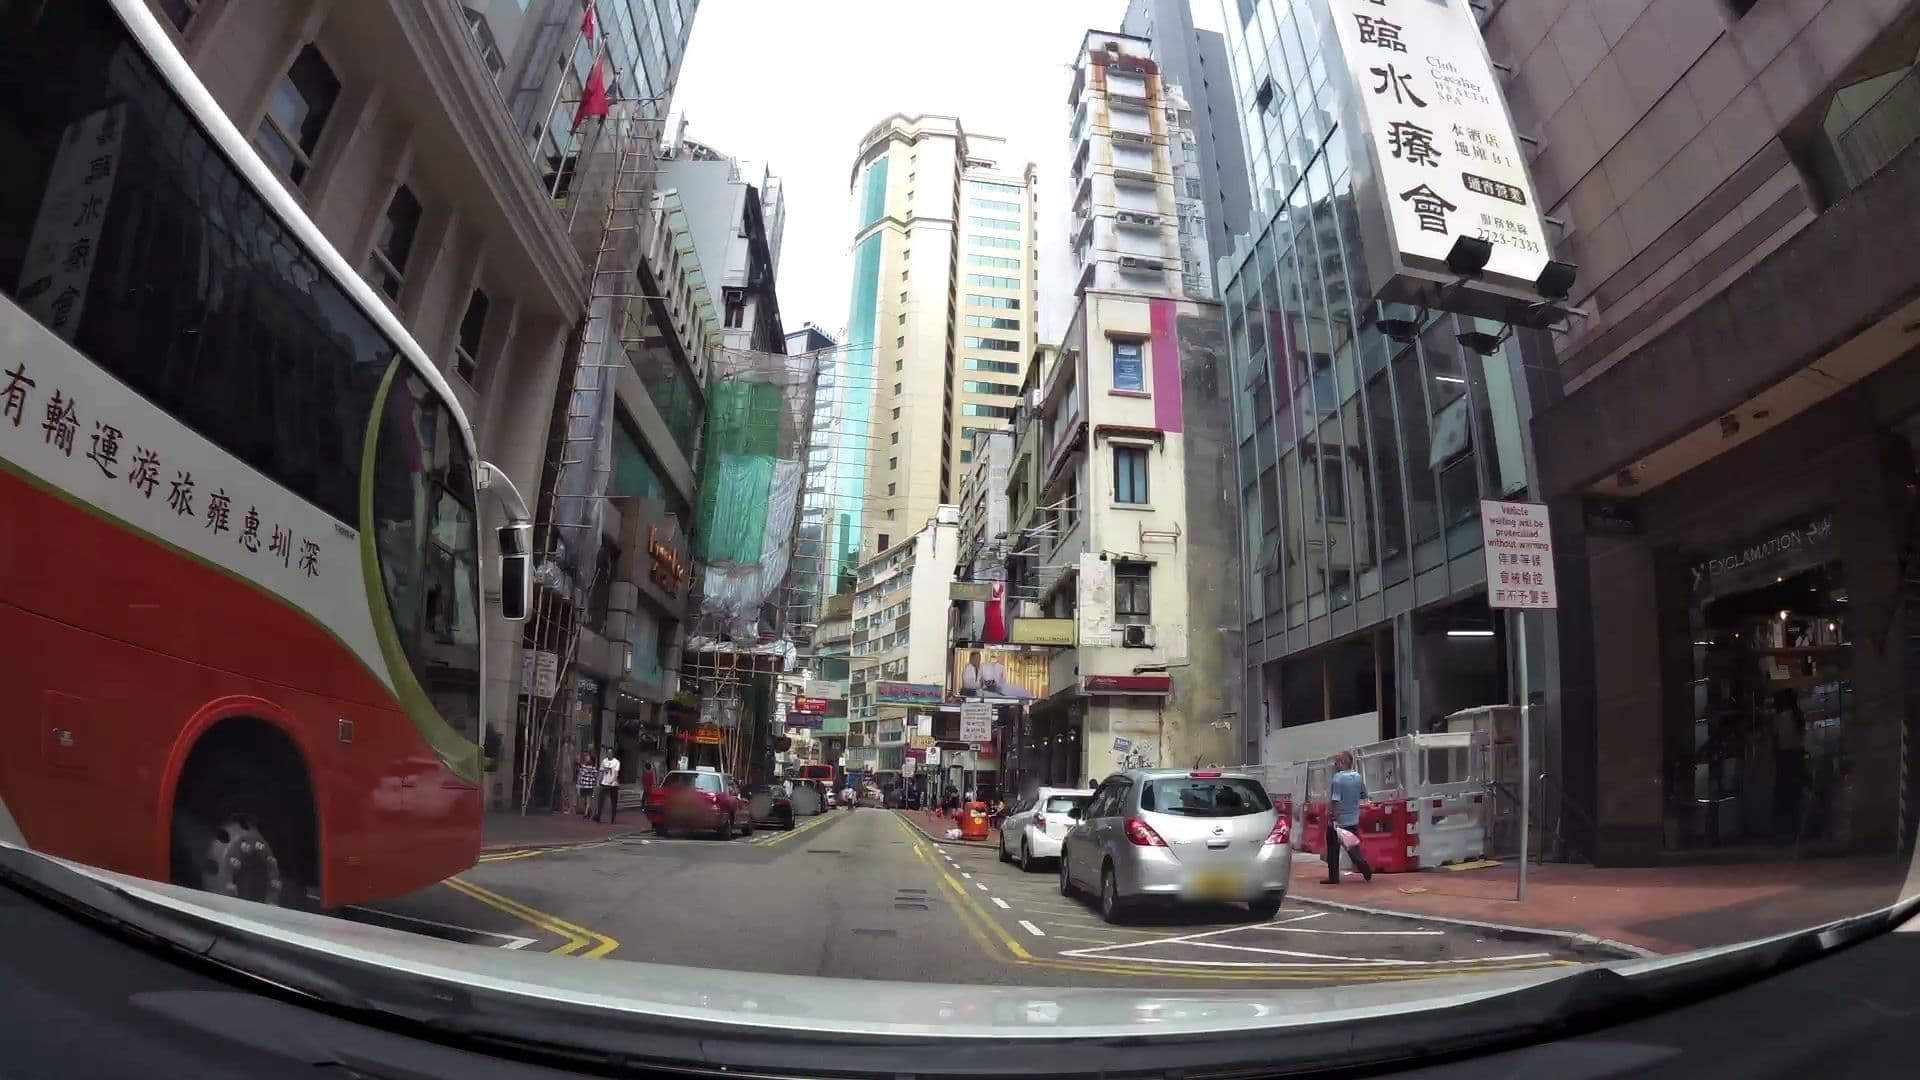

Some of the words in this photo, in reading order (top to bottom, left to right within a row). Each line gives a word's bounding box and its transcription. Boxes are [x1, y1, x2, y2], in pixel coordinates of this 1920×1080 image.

[1352, 0, 1457, 235] 臨水療會
[1488, 539, 1517, 549] without
[1709, 529, 1802, 576] EXCLAMATION
